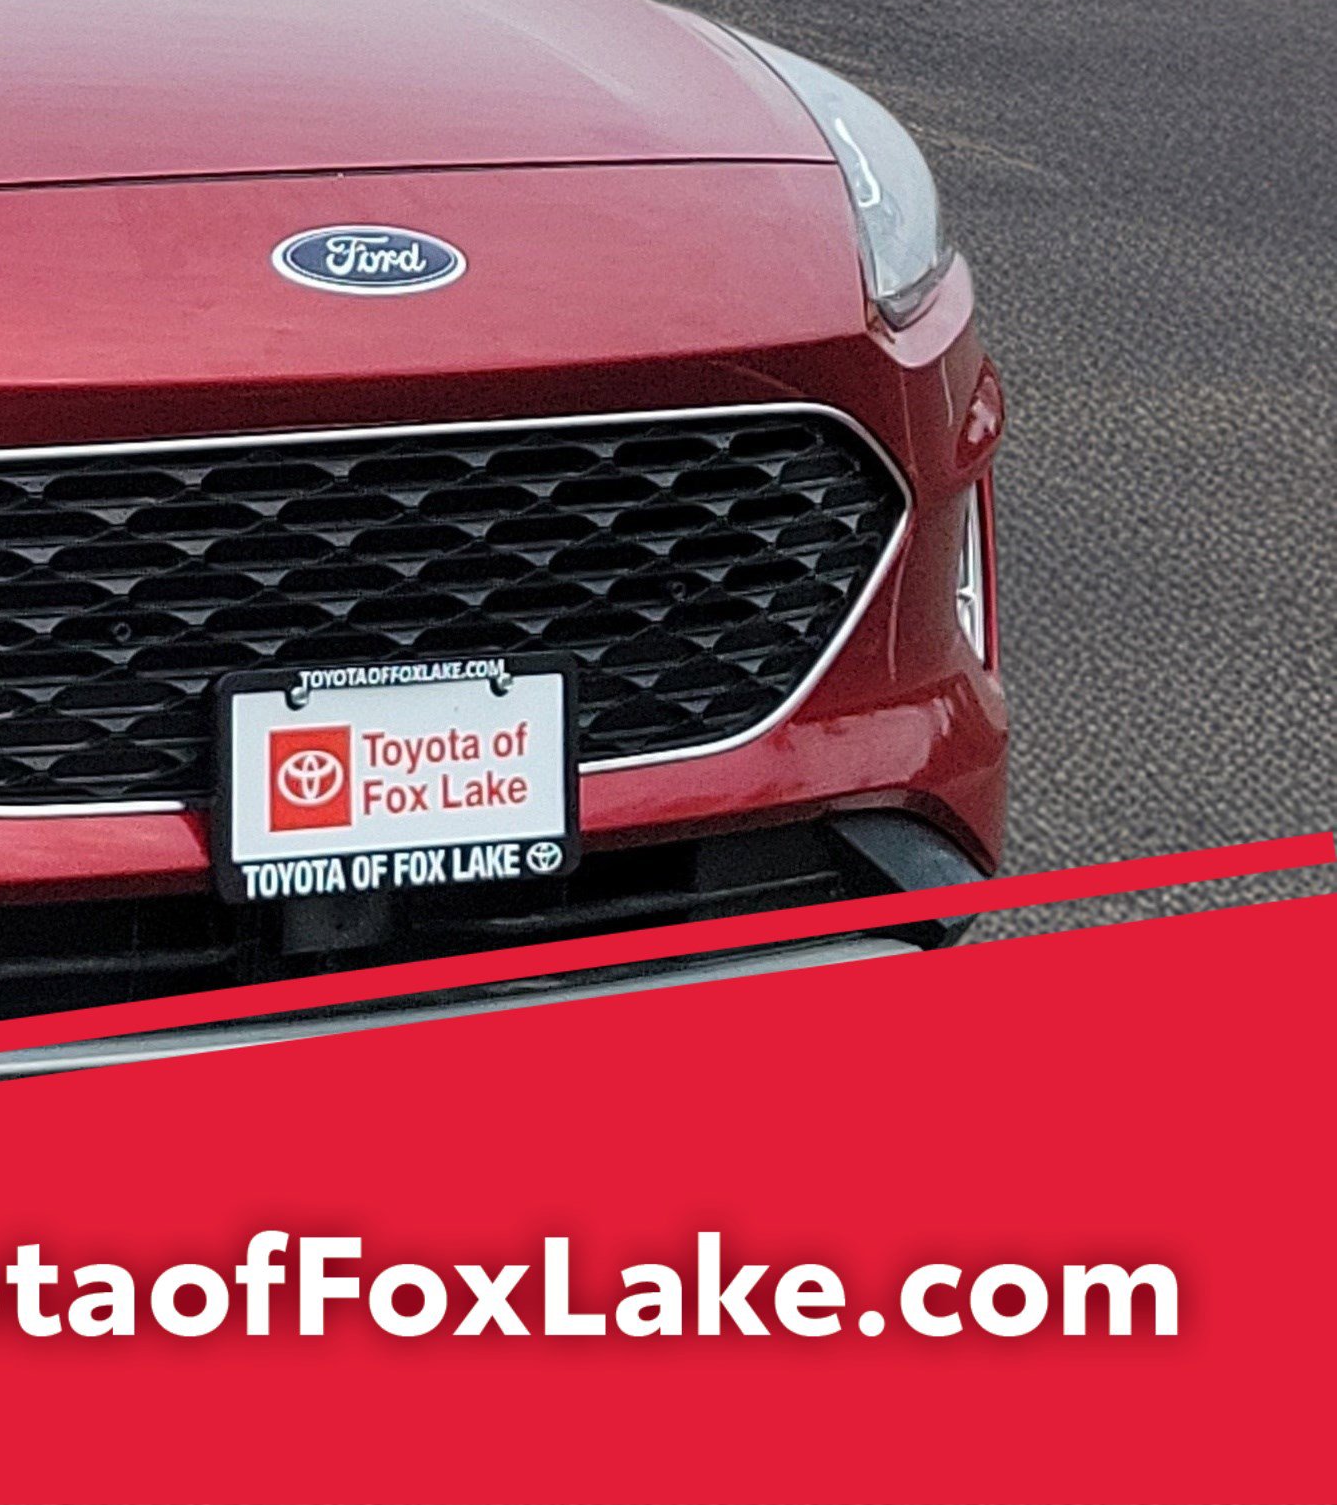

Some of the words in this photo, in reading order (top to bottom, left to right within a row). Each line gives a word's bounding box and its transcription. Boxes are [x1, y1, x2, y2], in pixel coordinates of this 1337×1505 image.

[325, 236, 426, 275] Ford
[299, 659, 506, 688] TOYOTAOFFOXLAKE.COM
[362, 727, 480, 774] Toyota
[492, 722, 528, 758] of
[362, 779, 429, 815] Fox
[441, 772, 527, 810] Lake
[242, 860, 345, 898] TOYOTA
[351, 854, 388, 890] OF
[393, 848, 446, 885] FOX
[452, 842, 520, 881] LAKE
